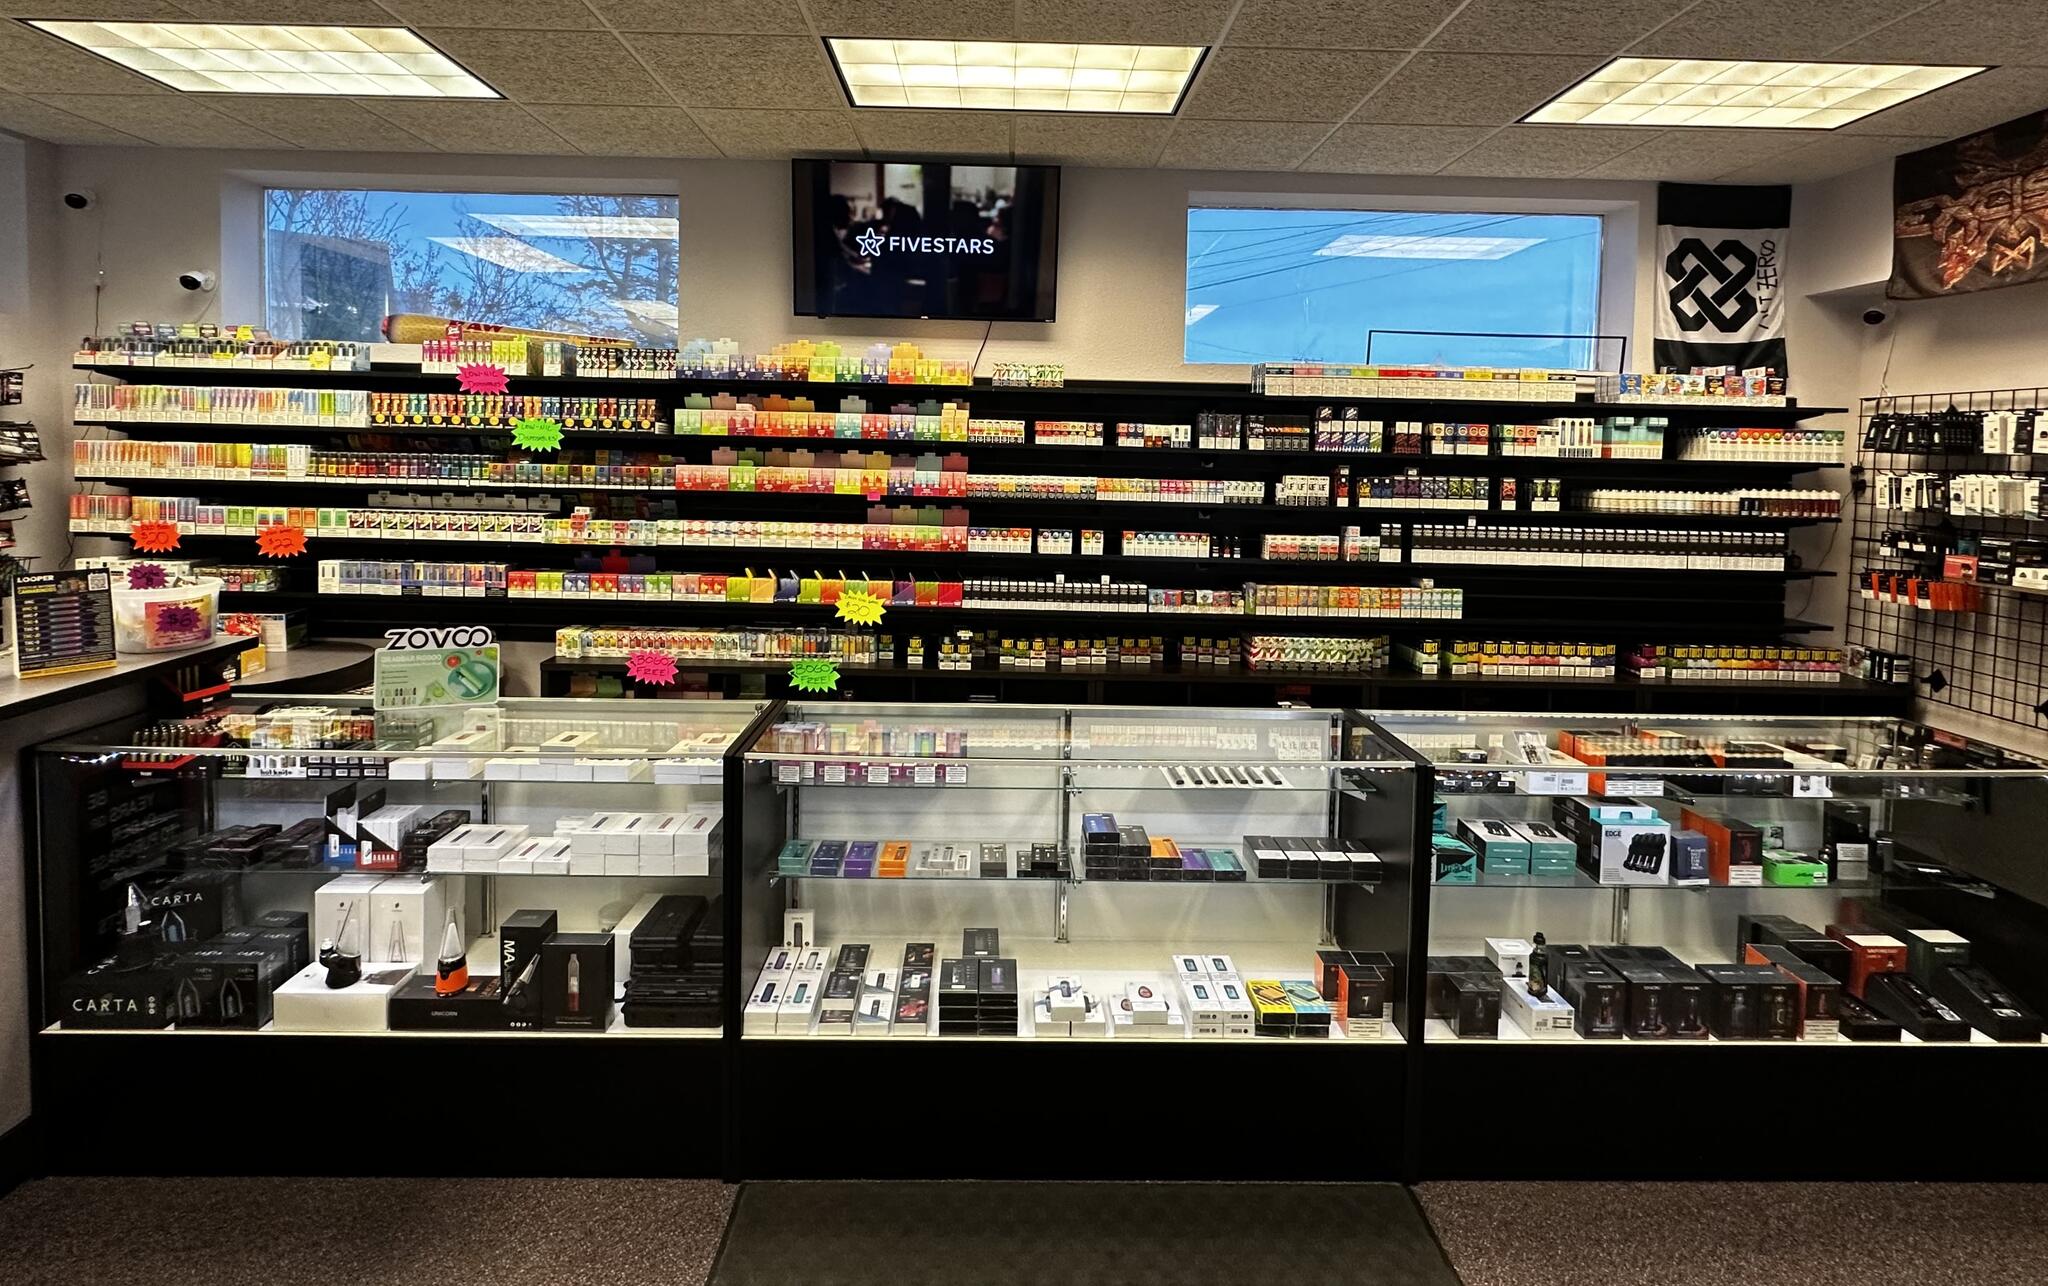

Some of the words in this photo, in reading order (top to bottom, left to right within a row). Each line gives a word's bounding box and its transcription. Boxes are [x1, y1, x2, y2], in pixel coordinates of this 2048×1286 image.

[889, 236, 994, 254] FIVESTARS
[589, 336, 619, 345] RAW
[141, 531, 169, 546] $20
[267, 537, 294, 550] $22
[16, 575, 54, 583] LOOPER
[846, 601, 871, 617] $20
[168, 612, 193, 628] $6
[387, 628, 490, 650] ZOVOO
[637, 655, 669, 666] BOGO
[796, 663, 831, 674] BOGO
[1604, 830, 1622, 838] EDGE
[151, 892, 204, 906] CARTA
[72, 998, 138, 1012] CARTA
